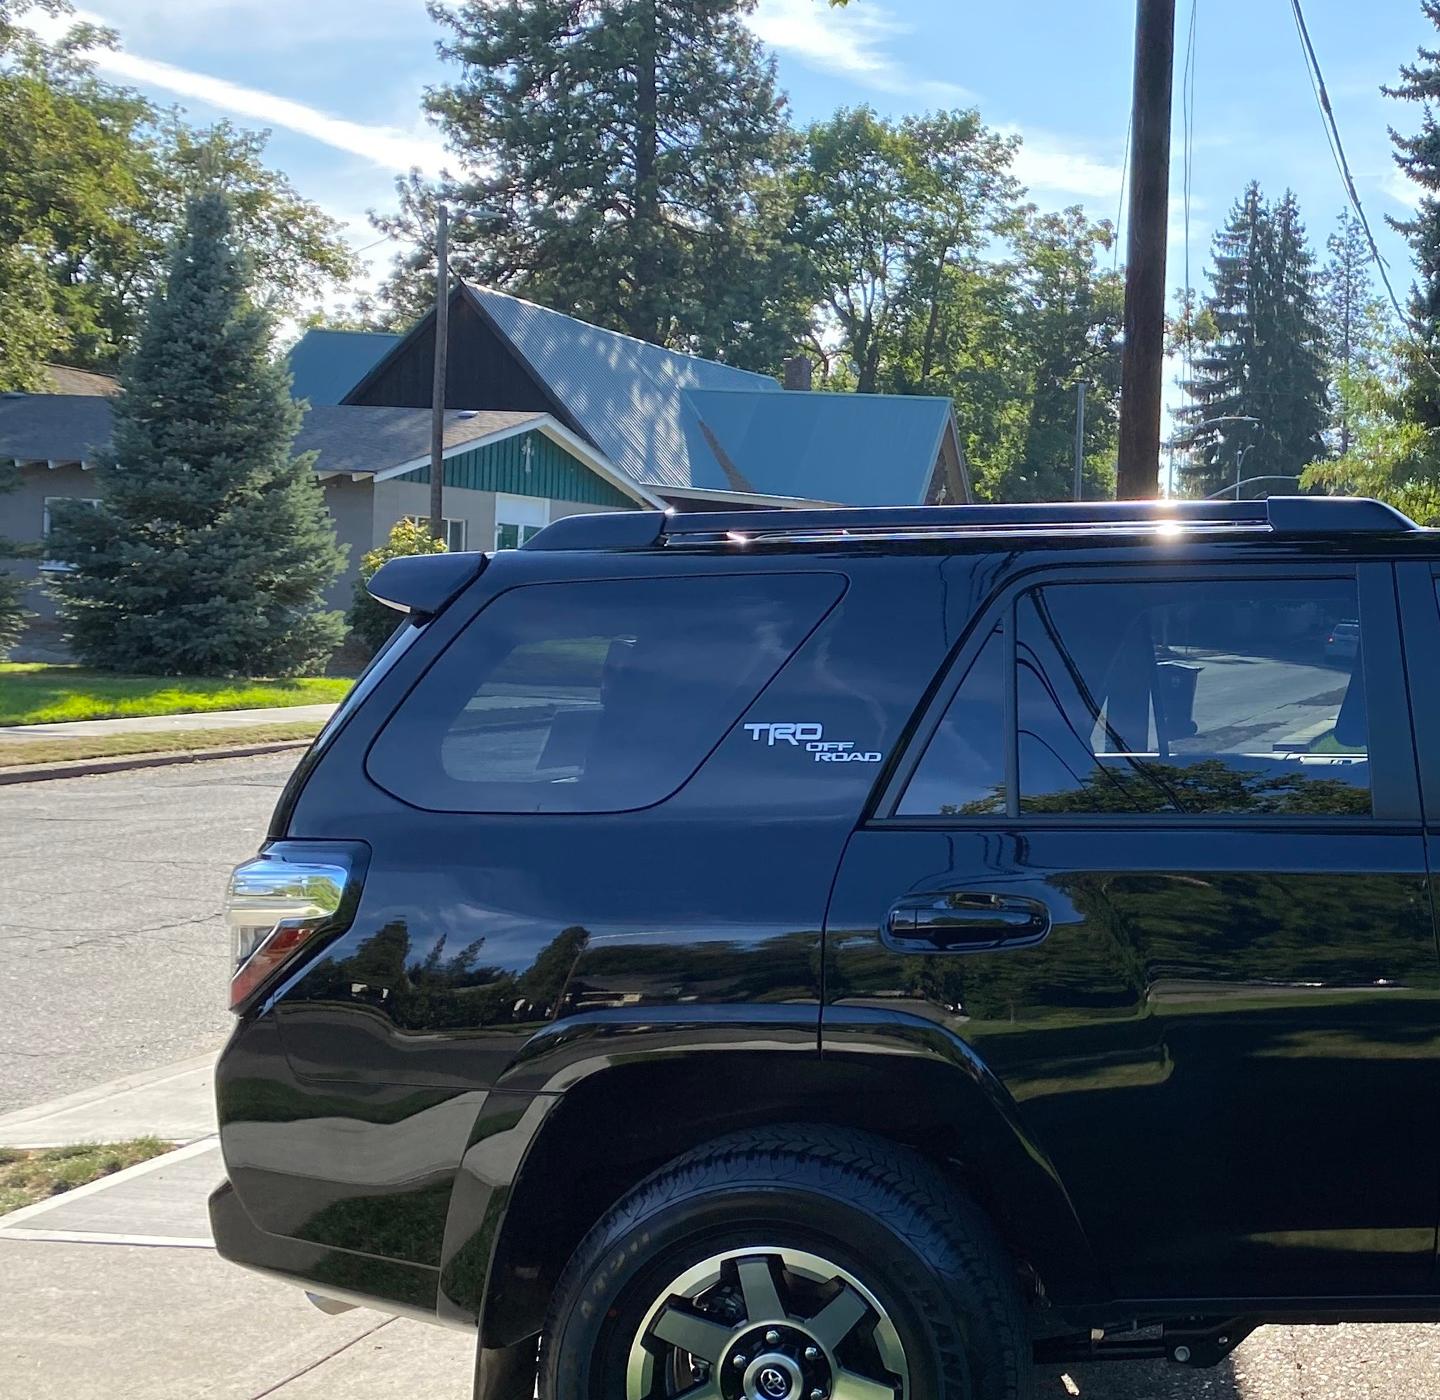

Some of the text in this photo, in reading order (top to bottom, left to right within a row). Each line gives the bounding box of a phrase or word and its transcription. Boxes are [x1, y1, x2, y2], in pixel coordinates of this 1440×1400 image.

[743, 723, 823, 746] TRD
[805, 742, 855, 752] OFF
[814, 752, 882, 762] ROAD
